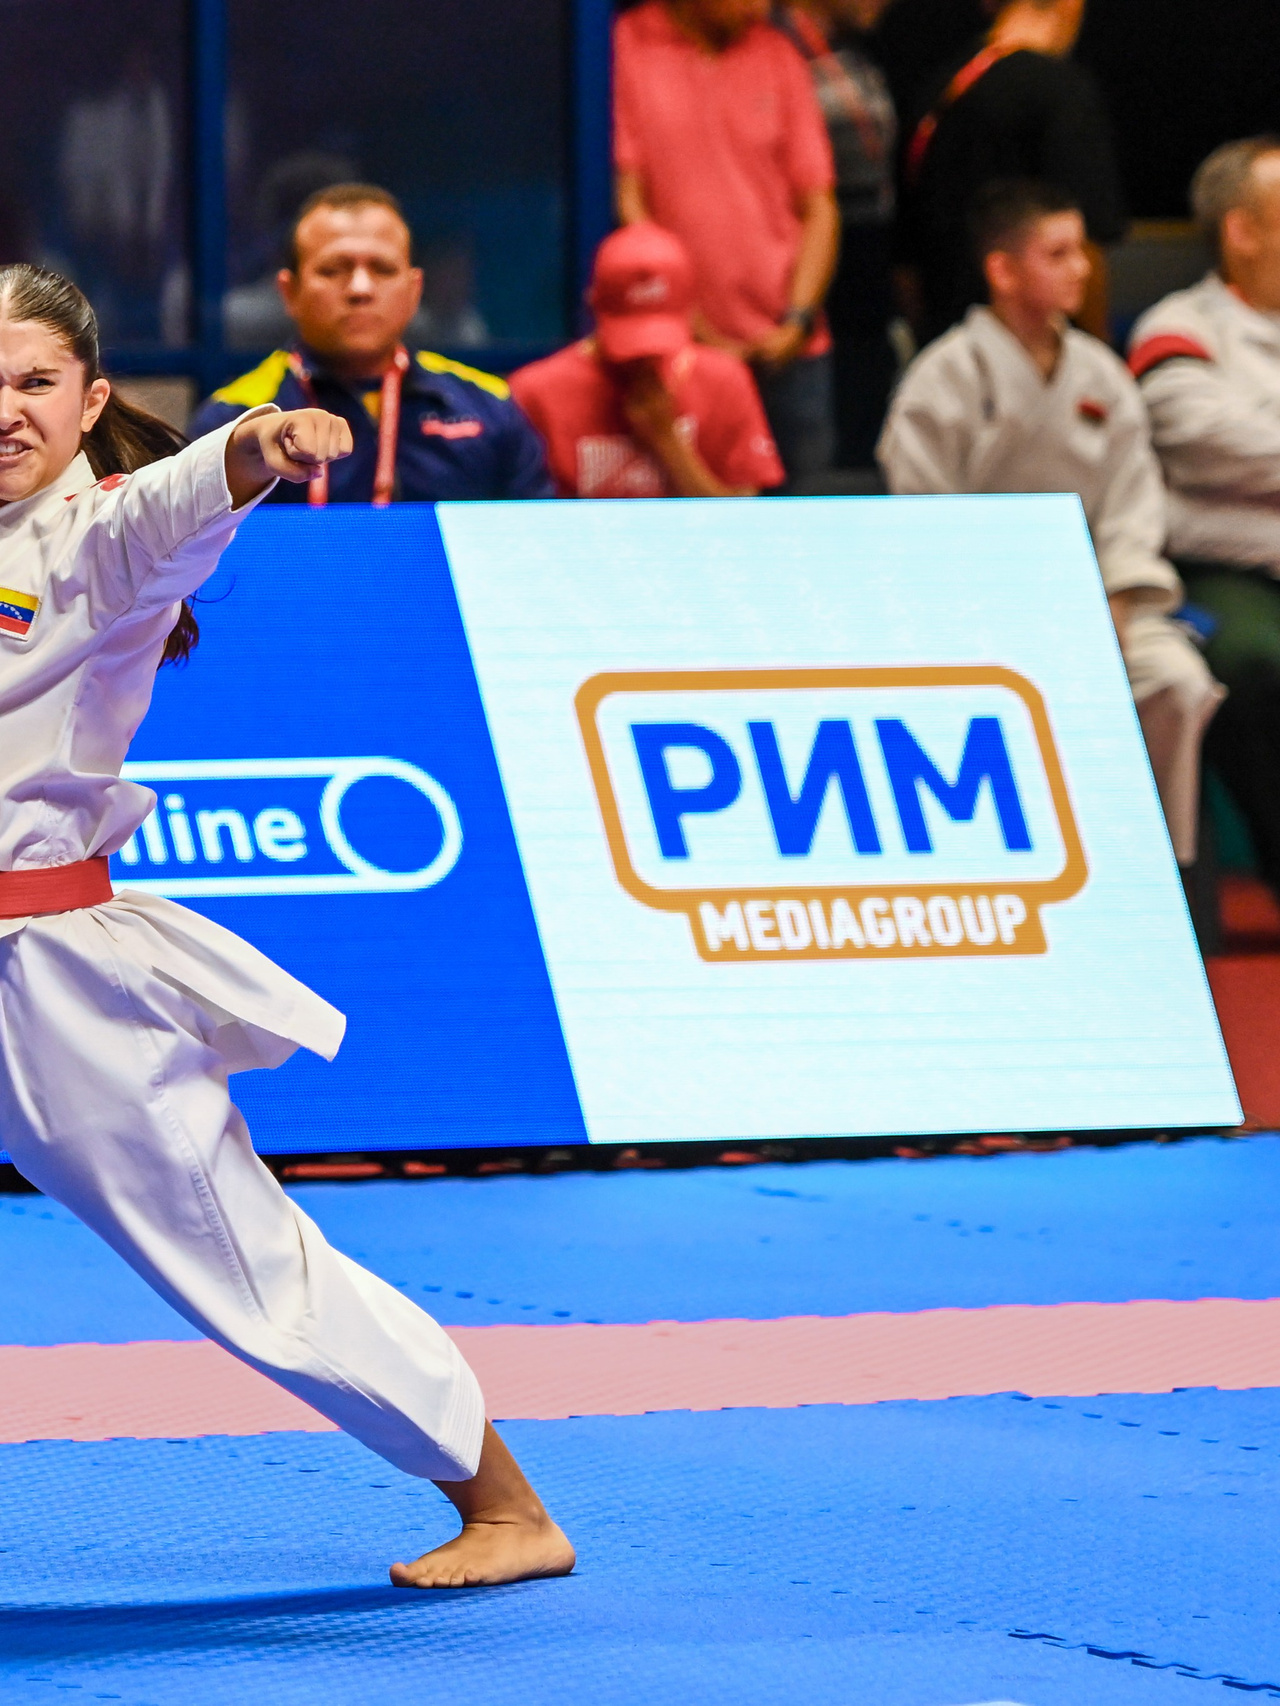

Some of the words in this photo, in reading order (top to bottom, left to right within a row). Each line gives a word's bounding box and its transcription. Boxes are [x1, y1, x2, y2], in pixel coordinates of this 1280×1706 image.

[630, 715, 1034, 861] РИМ
[120, 793, 308, 864] line
[697, 894, 1028, 953] MEDIAGROUP
